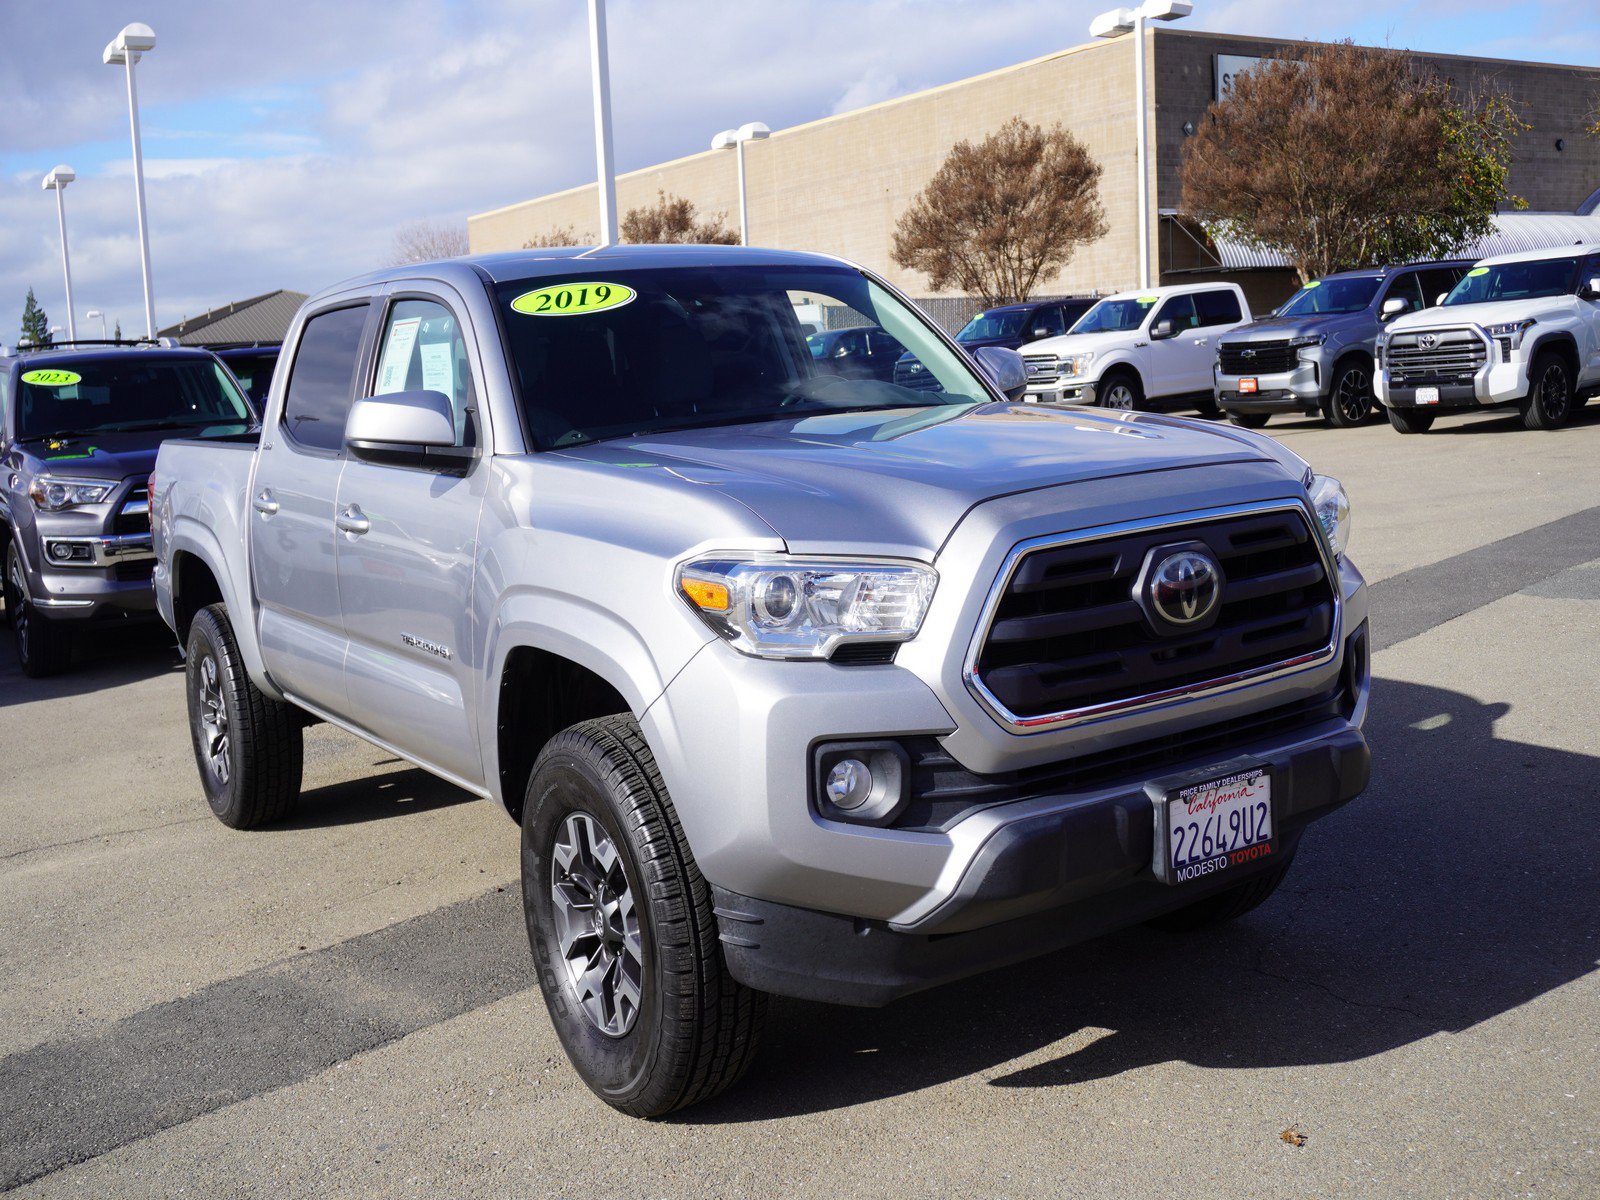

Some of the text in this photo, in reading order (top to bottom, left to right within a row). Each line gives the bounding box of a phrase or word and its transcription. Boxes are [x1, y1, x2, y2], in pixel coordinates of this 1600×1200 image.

[535, 285, 611, 312] 2019
[29, 372, 71, 383] 2023
[1179, 785, 1198, 799] PRICE
[1199, 780, 1221, 795] FAMILY
[1222, 769, 1263, 786] DEALERSHIPS
[1187, 785, 1256, 815] California
[1173, 801, 1268, 868] 22649U2
[1177, 842, 1272, 883] MODESTO TOYOTA
